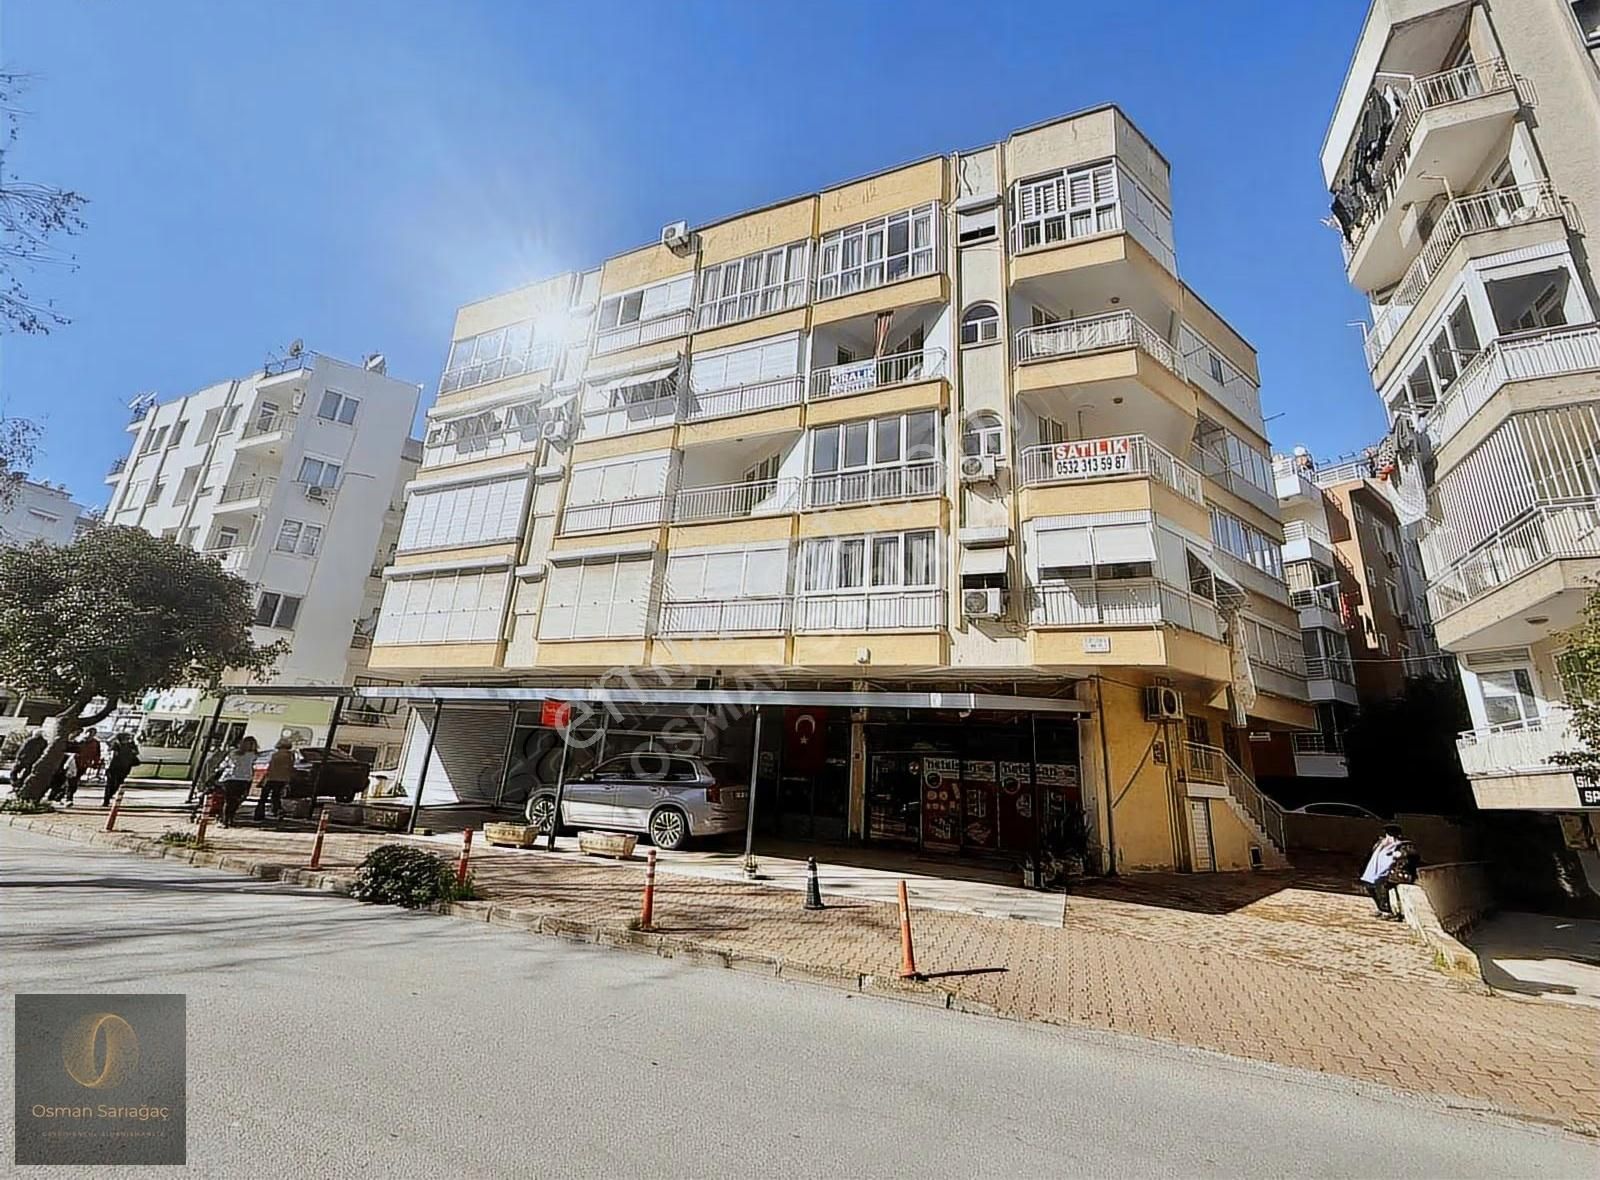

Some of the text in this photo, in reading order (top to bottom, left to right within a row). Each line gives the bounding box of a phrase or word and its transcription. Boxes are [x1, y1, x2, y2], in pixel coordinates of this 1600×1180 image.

[1055, 439, 1128, 461] SATILIK
[1056, 455, 1127, 475] 0532 313 59 87
